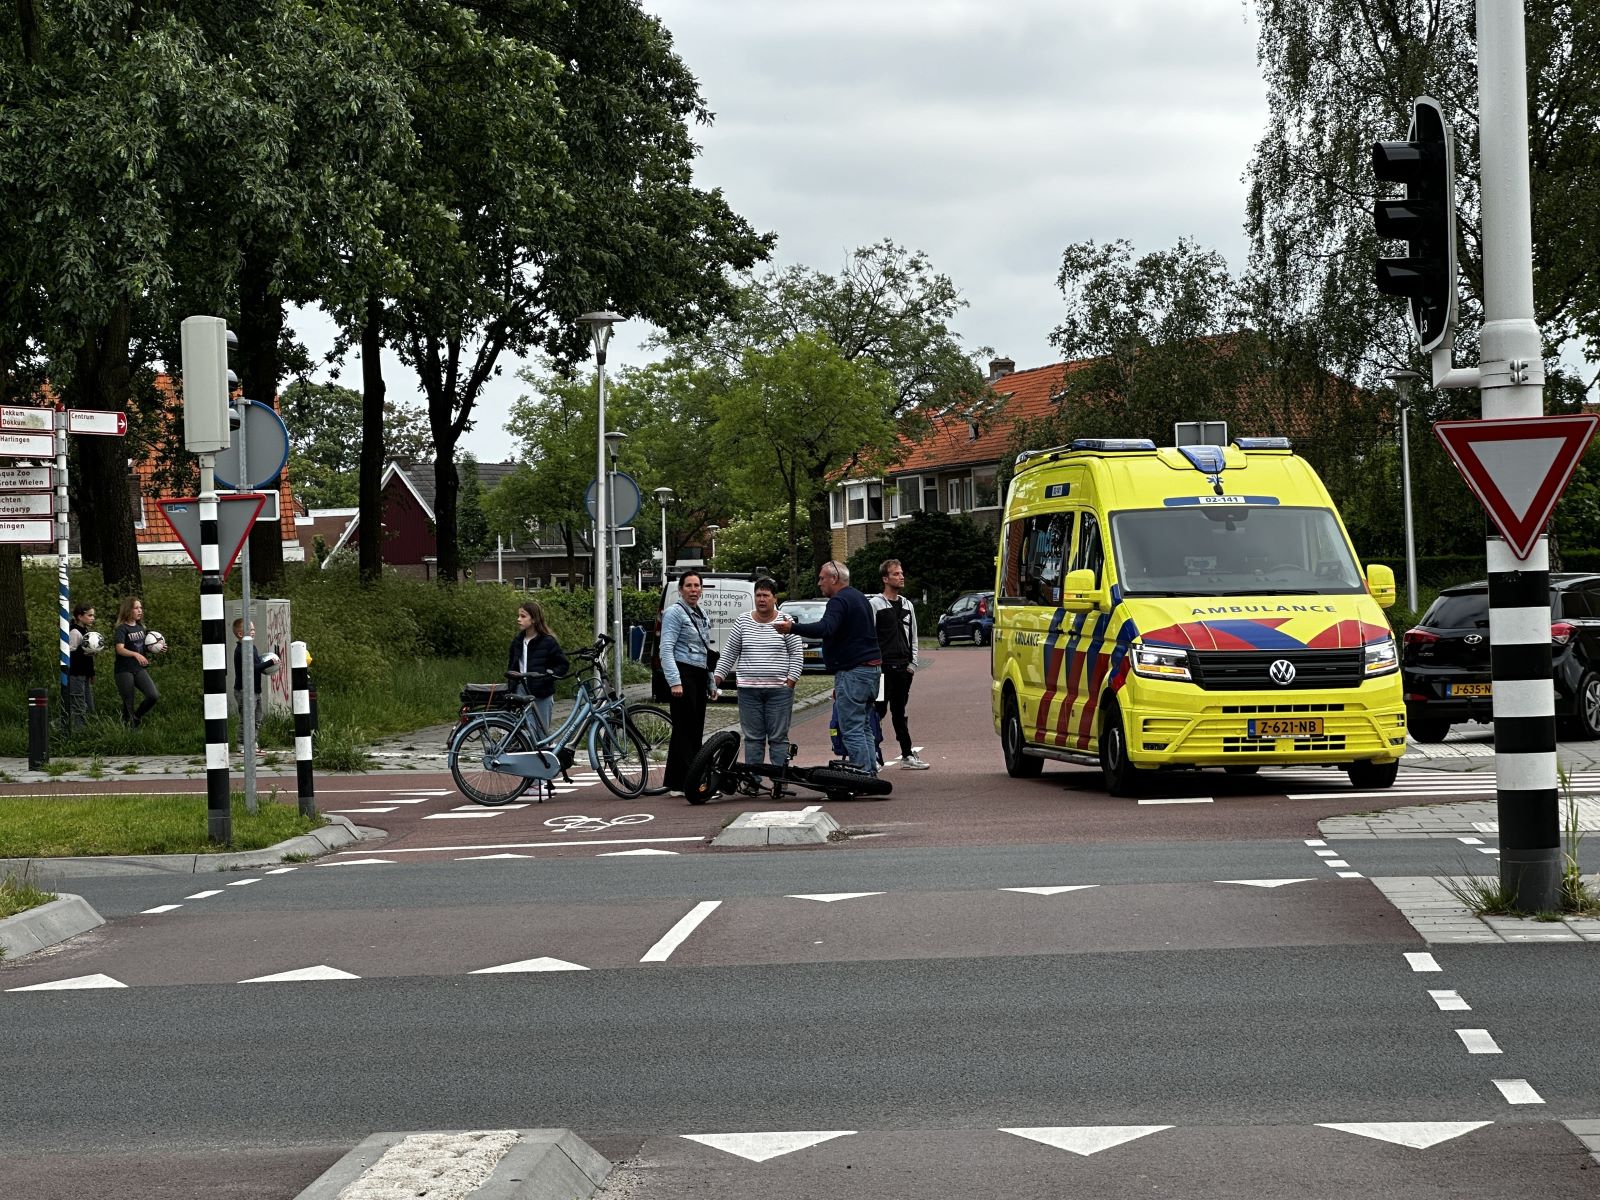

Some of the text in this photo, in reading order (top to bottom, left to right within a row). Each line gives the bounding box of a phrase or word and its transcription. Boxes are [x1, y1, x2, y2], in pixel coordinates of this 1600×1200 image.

[0, 436, 30, 444] Harlingen
[720, 593, 748, 601] collega?
[1191, 605, 1337, 616] AMBULANCE
[1454, 684, 1492, 695] J-635-N
[1261, 721, 1317, 734] Z-621-NB
